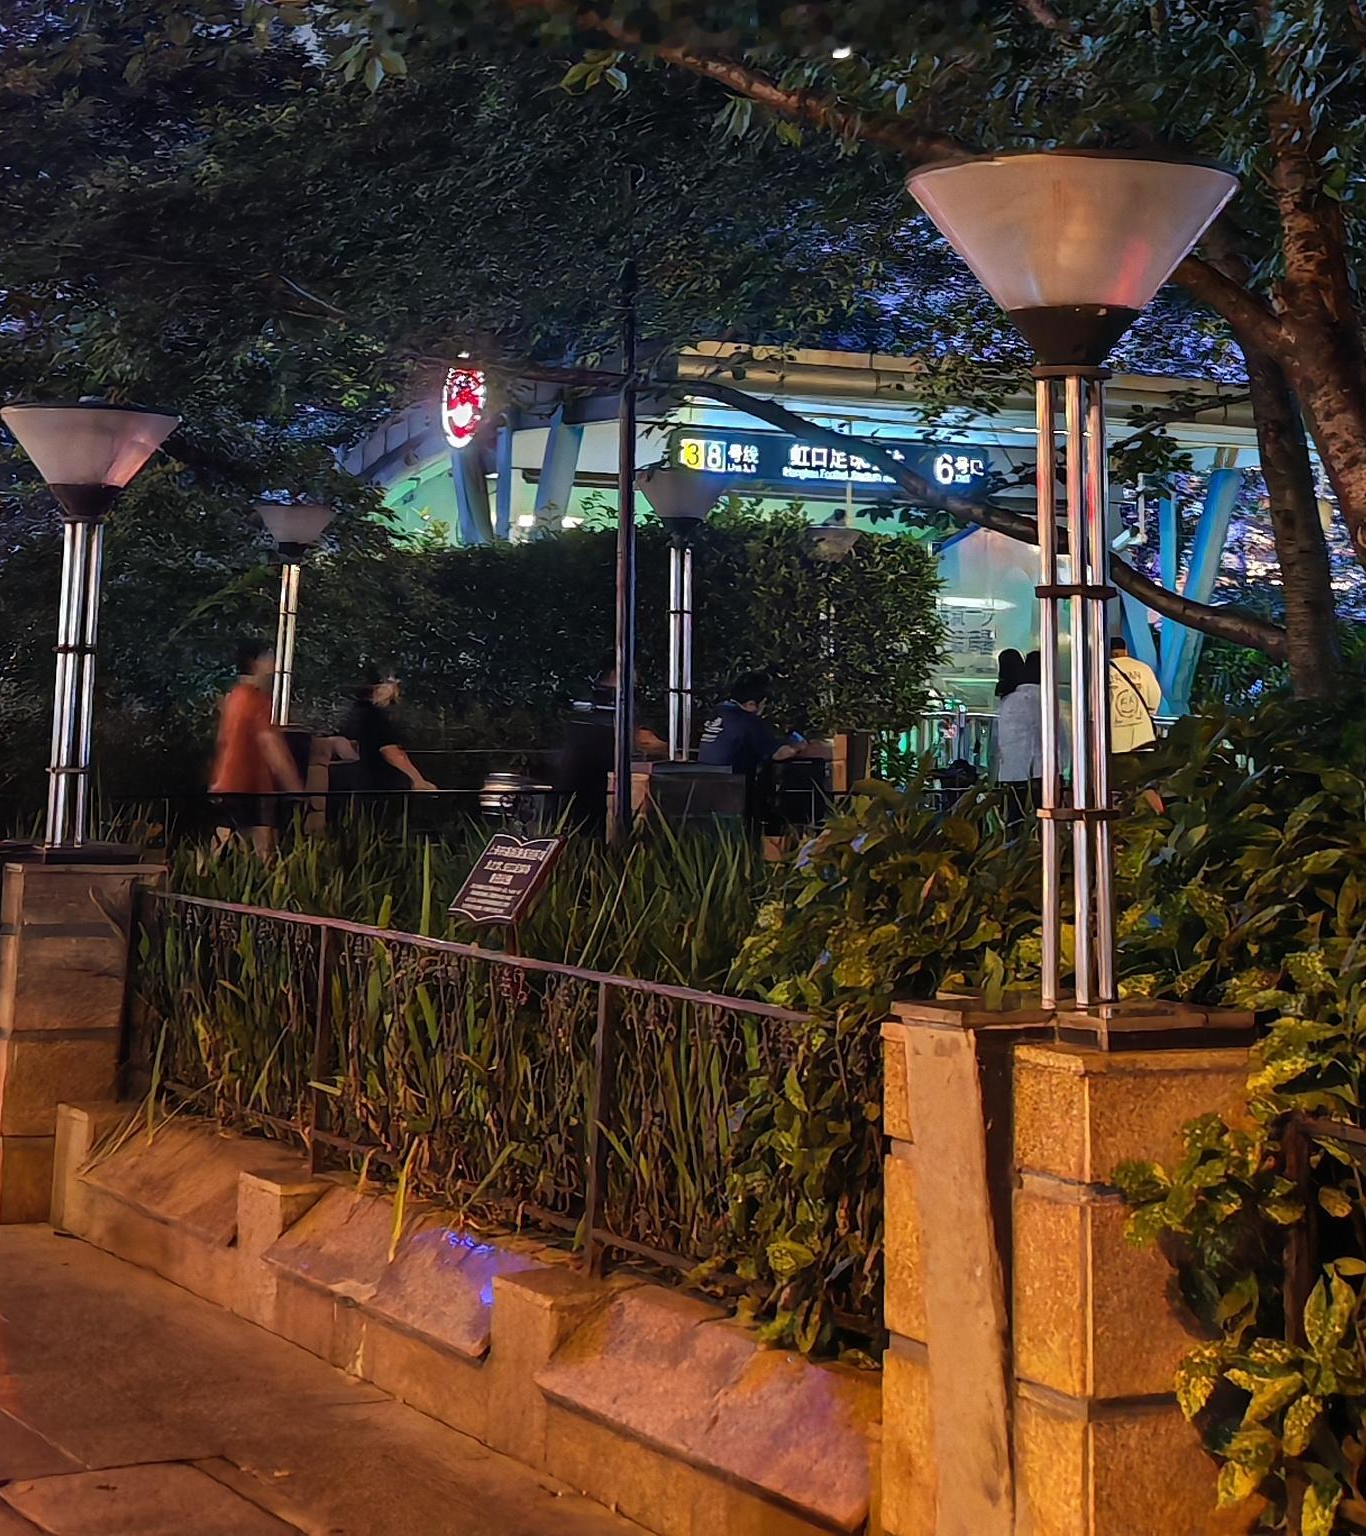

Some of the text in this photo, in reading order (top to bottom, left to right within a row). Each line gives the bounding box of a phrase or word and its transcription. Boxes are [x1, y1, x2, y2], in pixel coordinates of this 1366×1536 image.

[686, 443, 699, 465] 3
[707, 444, 721, 468] 8
[727, 444, 759, 464] 号线
